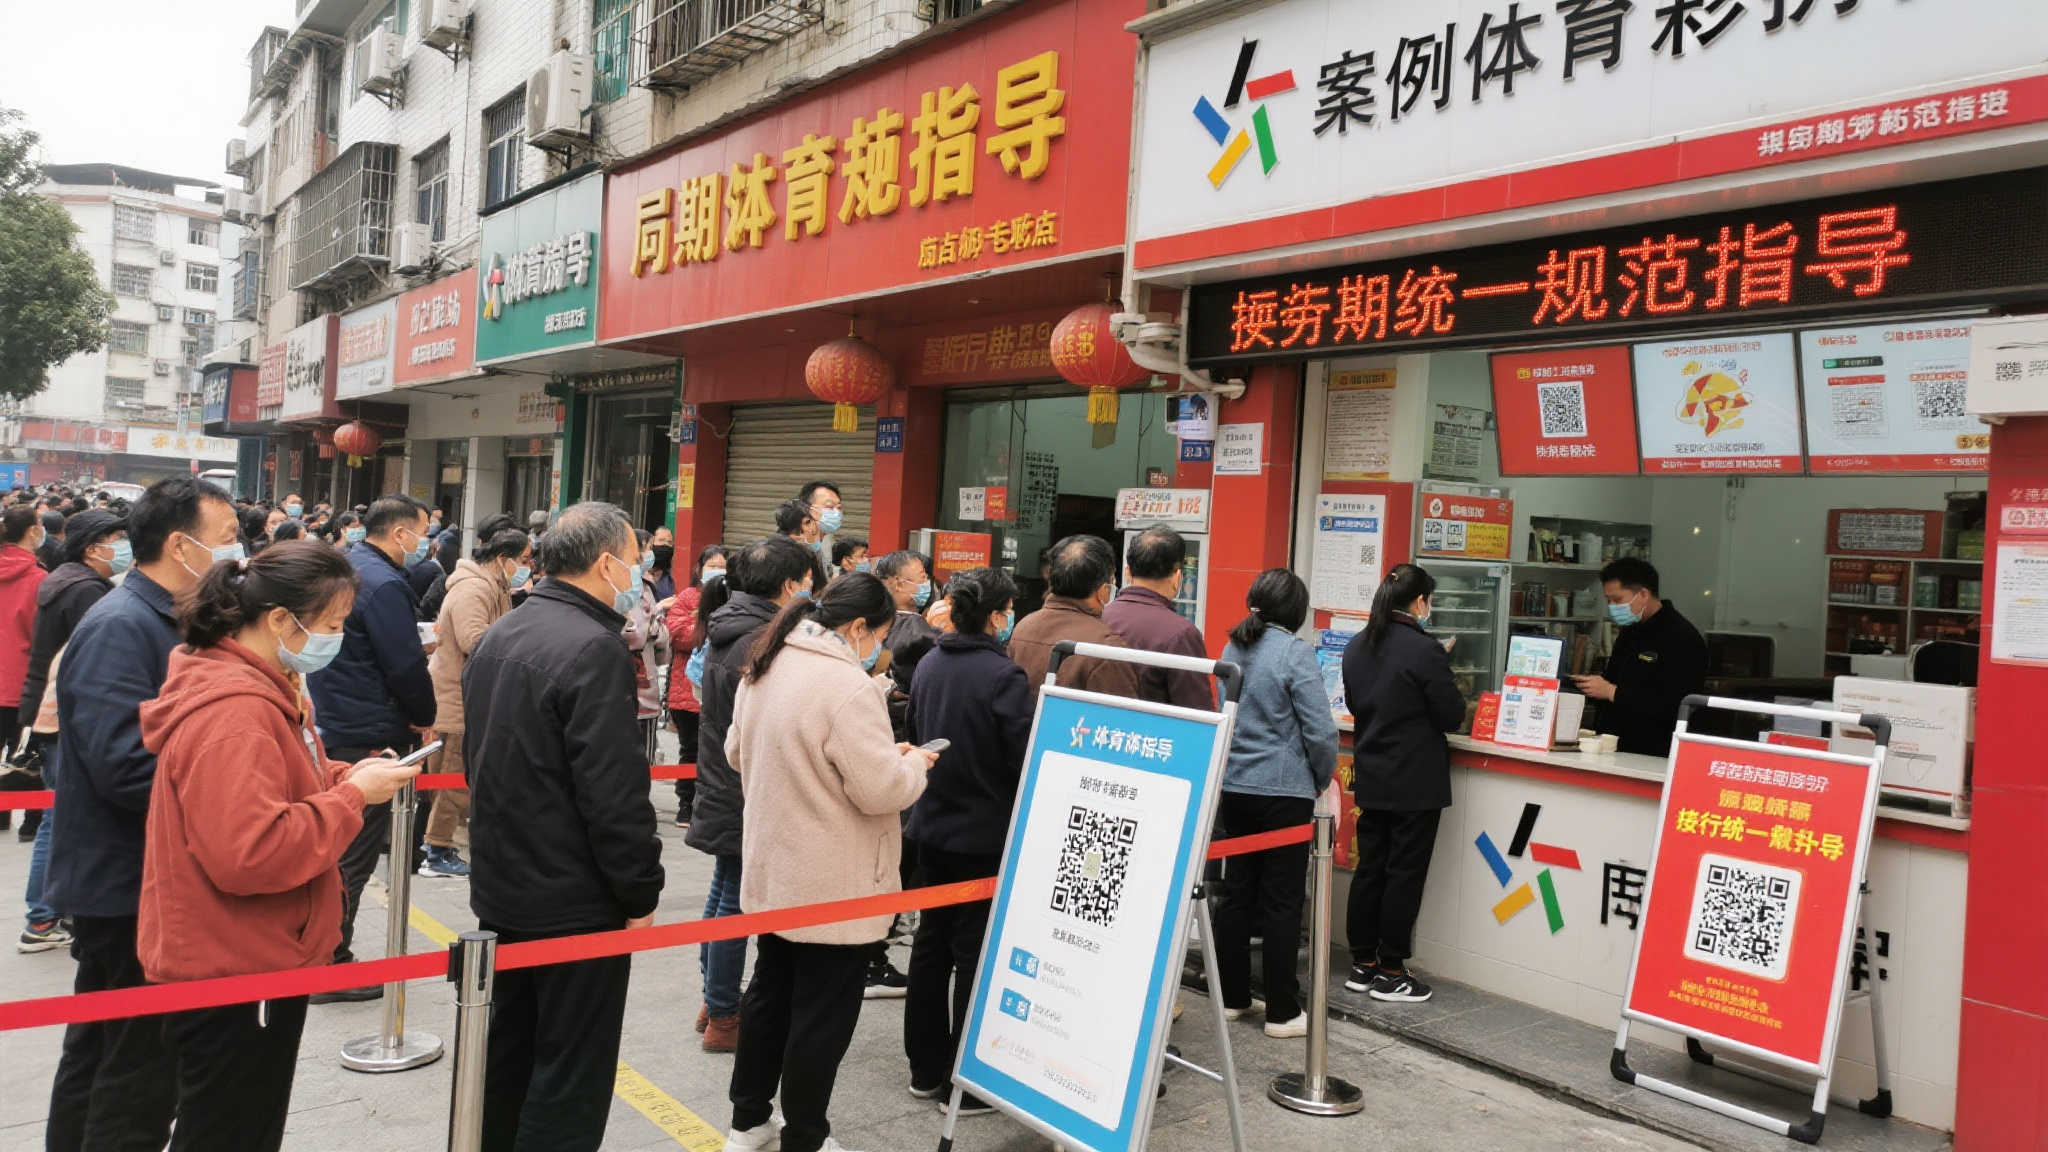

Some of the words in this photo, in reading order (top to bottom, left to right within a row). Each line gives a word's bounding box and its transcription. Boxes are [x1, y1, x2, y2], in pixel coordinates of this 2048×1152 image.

[1313, 0, 1860, 137] 案例体育彩
